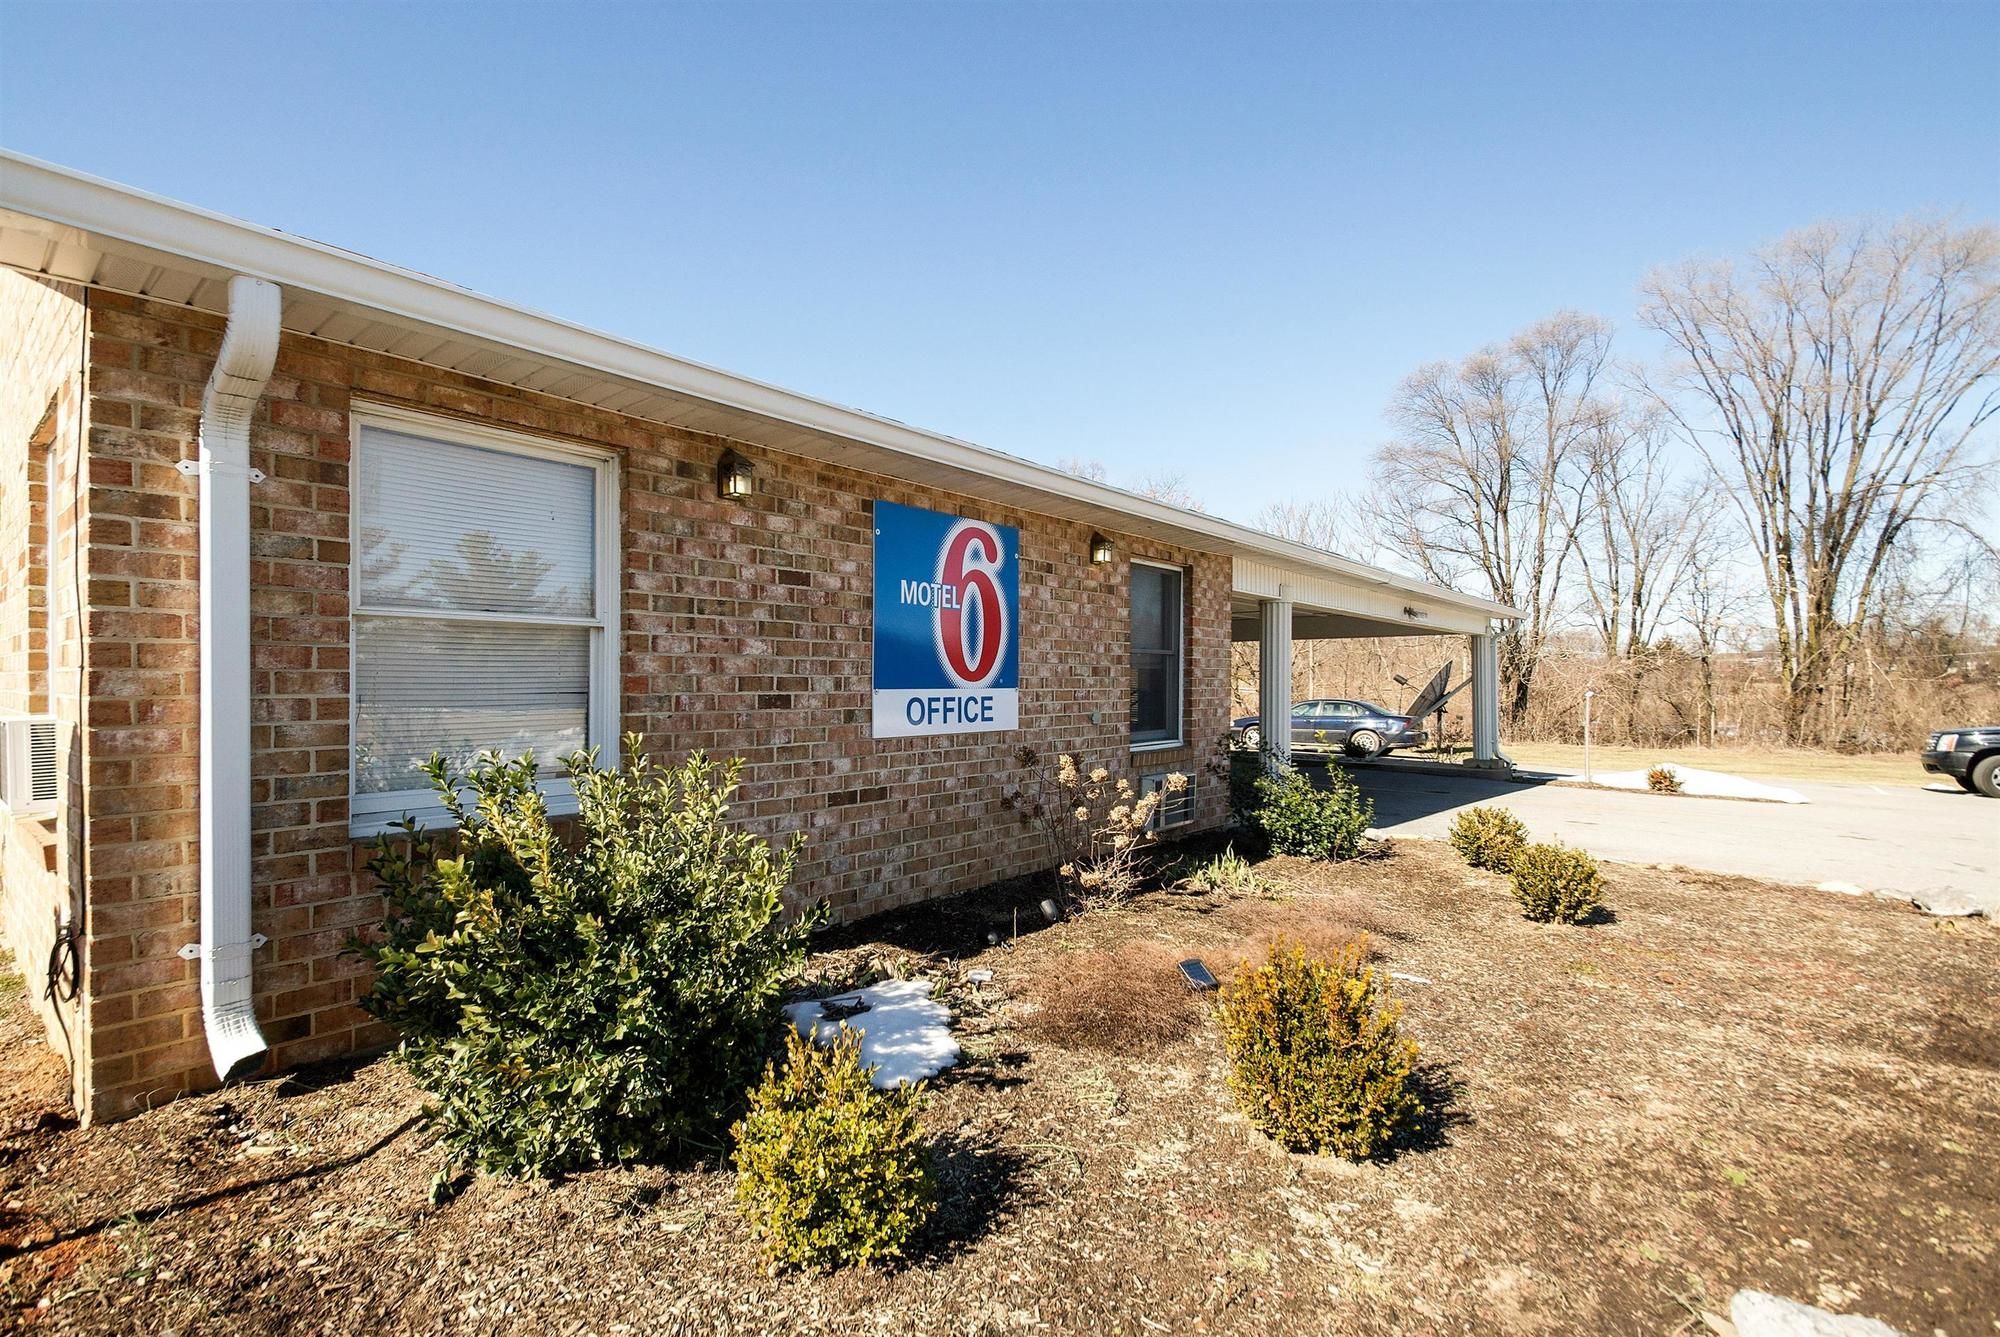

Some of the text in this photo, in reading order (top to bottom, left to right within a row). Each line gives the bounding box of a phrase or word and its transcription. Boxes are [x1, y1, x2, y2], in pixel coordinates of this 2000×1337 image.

[900, 526, 1002, 683] MOTEL 6
[906, 695, 993, 726] OFFICE
